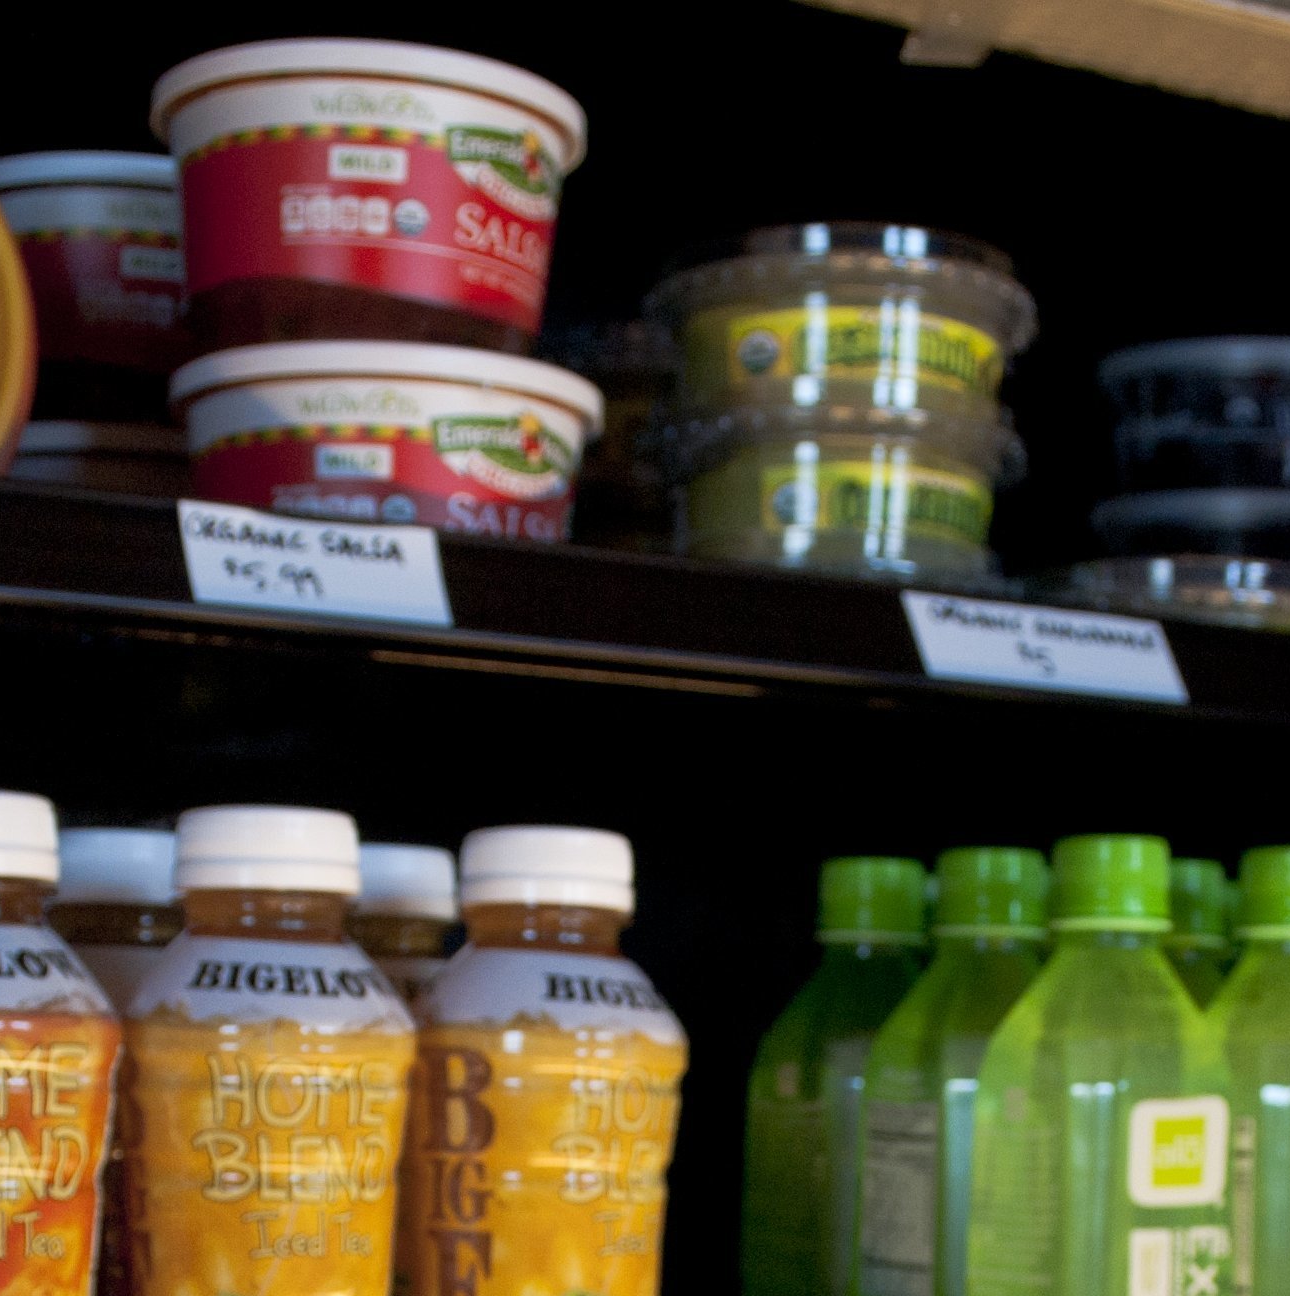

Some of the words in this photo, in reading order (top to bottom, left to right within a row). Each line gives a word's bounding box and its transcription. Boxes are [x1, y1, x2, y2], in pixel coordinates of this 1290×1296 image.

[207, 1051, 398, 1130] HOME
[191, 1127, 393, 1201] BLEND
[13, 1211, 66, 1260] Tea
[242, 1210, 327, 1259] Iced
